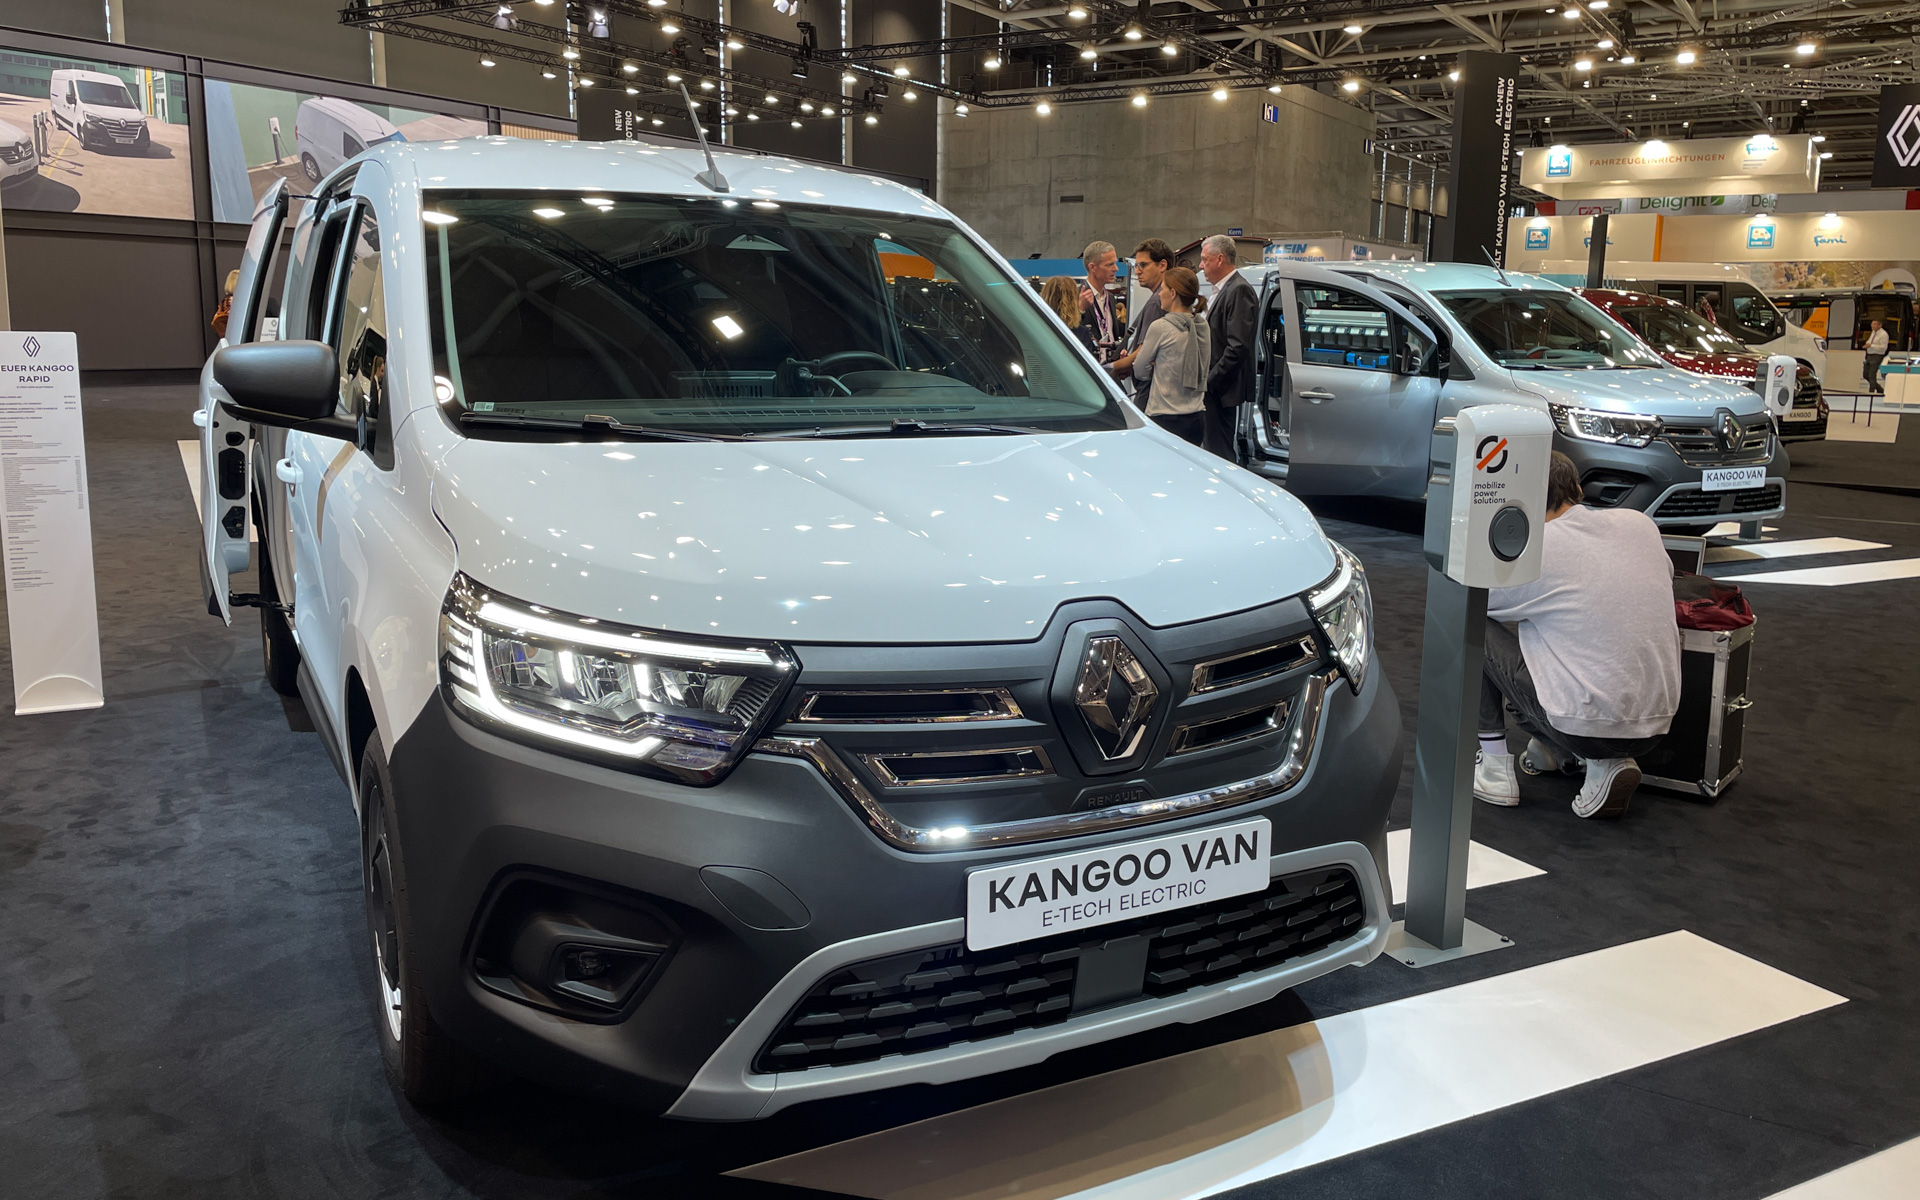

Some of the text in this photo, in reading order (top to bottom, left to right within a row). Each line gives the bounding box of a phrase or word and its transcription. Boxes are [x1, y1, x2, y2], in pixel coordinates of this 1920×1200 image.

[1495, 77, 1505, 127] ALL-NEW
[1504, 77, 1515, 131] ELECTRIC
[1501, 133, 1511, 172] E-TECH
[1589, 154, 1725, 166] FAHRZEUGEINRICHTUNGEN
[1499, 174, 1508, 198] VAN
[1496, 199, 1506, 248] KANGOO
[1264, 243, 1308, 254] KLEIN
[1, 364, 75, 372] EUER KANGOO
[19, 375, 51, 383] RAPID
[1706, 469, 1764, 482] KANGOO VAN
[1474, 481, 1506, 490] mobilize
[1473, 490, 1498, 498] power
[1473, 497, 1506, 505] solutions
[1087, 789, 1143, 808] RENAULT
[988, 829, 1259, 914] KANGOO VAN
[1041, 878, 1207, 928] E-TECH ELECTRIC
